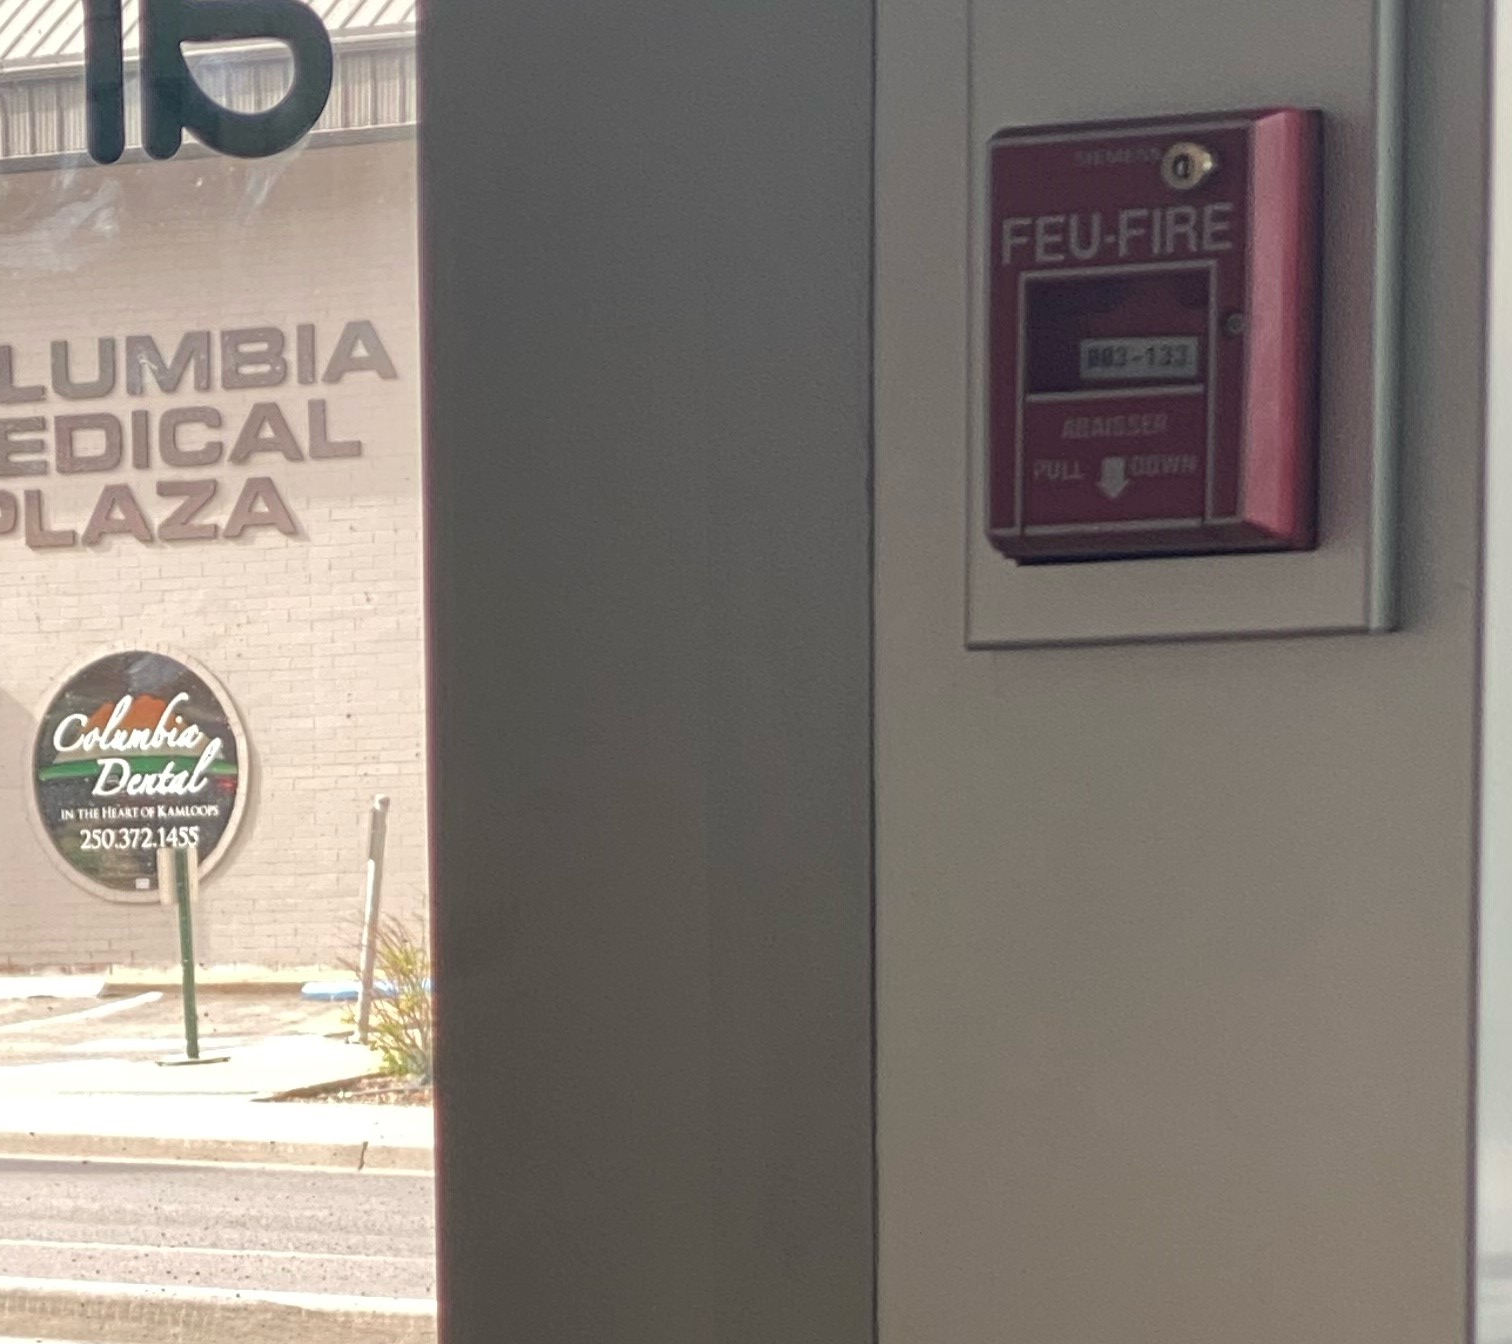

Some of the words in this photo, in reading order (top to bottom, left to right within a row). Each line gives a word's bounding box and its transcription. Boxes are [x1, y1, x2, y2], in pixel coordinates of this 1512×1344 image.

[53, 692, 201, 752] Columbia
[92, 737, 222, 795] Dental
[61, 808, 74, 820] IN
[78, 807, 99, 819] THE
[141, 806, 155, 818] OF
[80, 827, 200, 850] 250.372.1455
